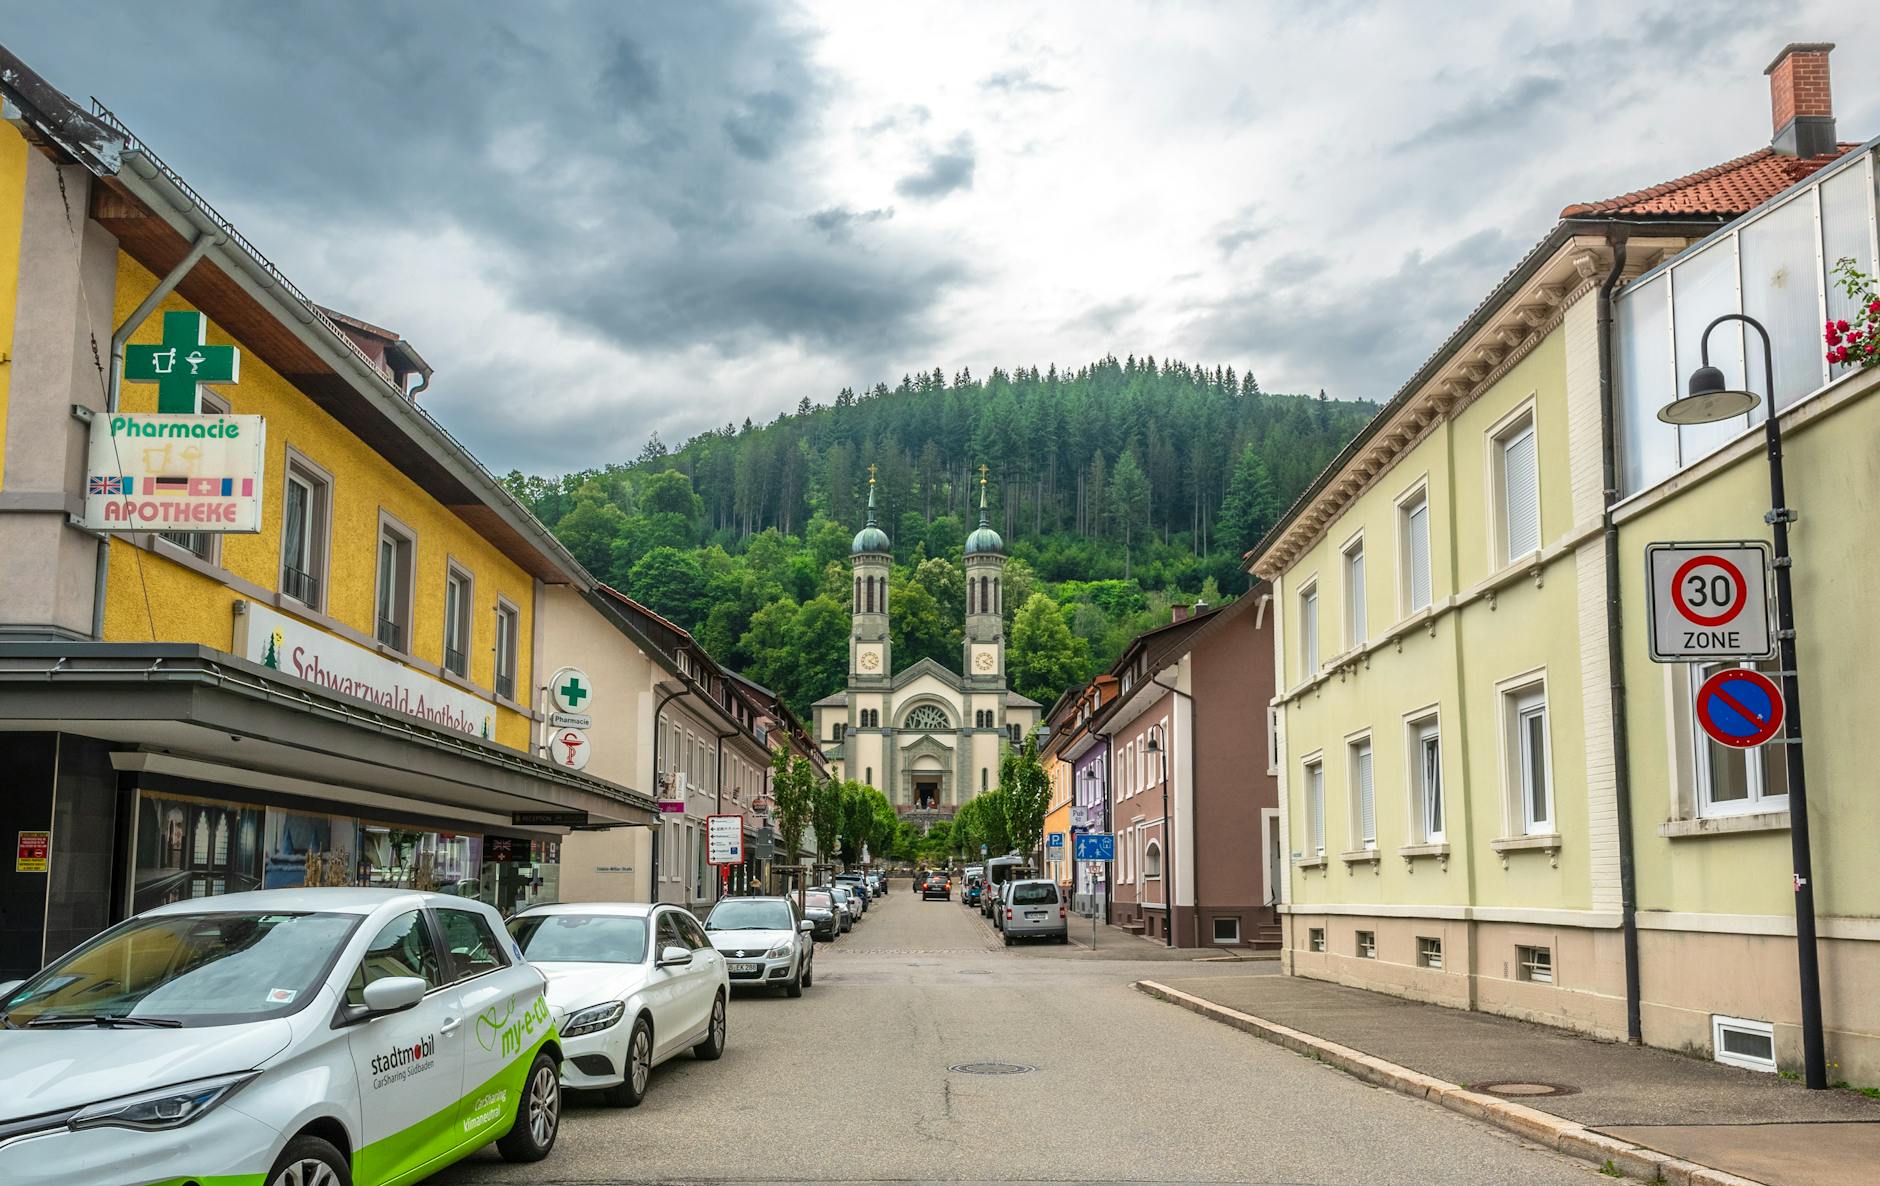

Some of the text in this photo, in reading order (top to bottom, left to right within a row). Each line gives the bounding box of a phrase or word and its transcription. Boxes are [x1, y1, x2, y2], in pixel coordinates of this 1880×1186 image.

[111, 417, 240, 439] Pharmacie
[104, 501, 237, 523] APOTHEKE
[1687, 575, 1731, 607] 30
[1683, 632, 1741, 649] ZONE
[554, 715, 590, 725] Pharmacie
[502, 993, 549, 1058] my-e-ca
[371, 1033, 435, 1075] stadtmobil
[373, 1060, 434, 1090] CarSharing Südbaden
